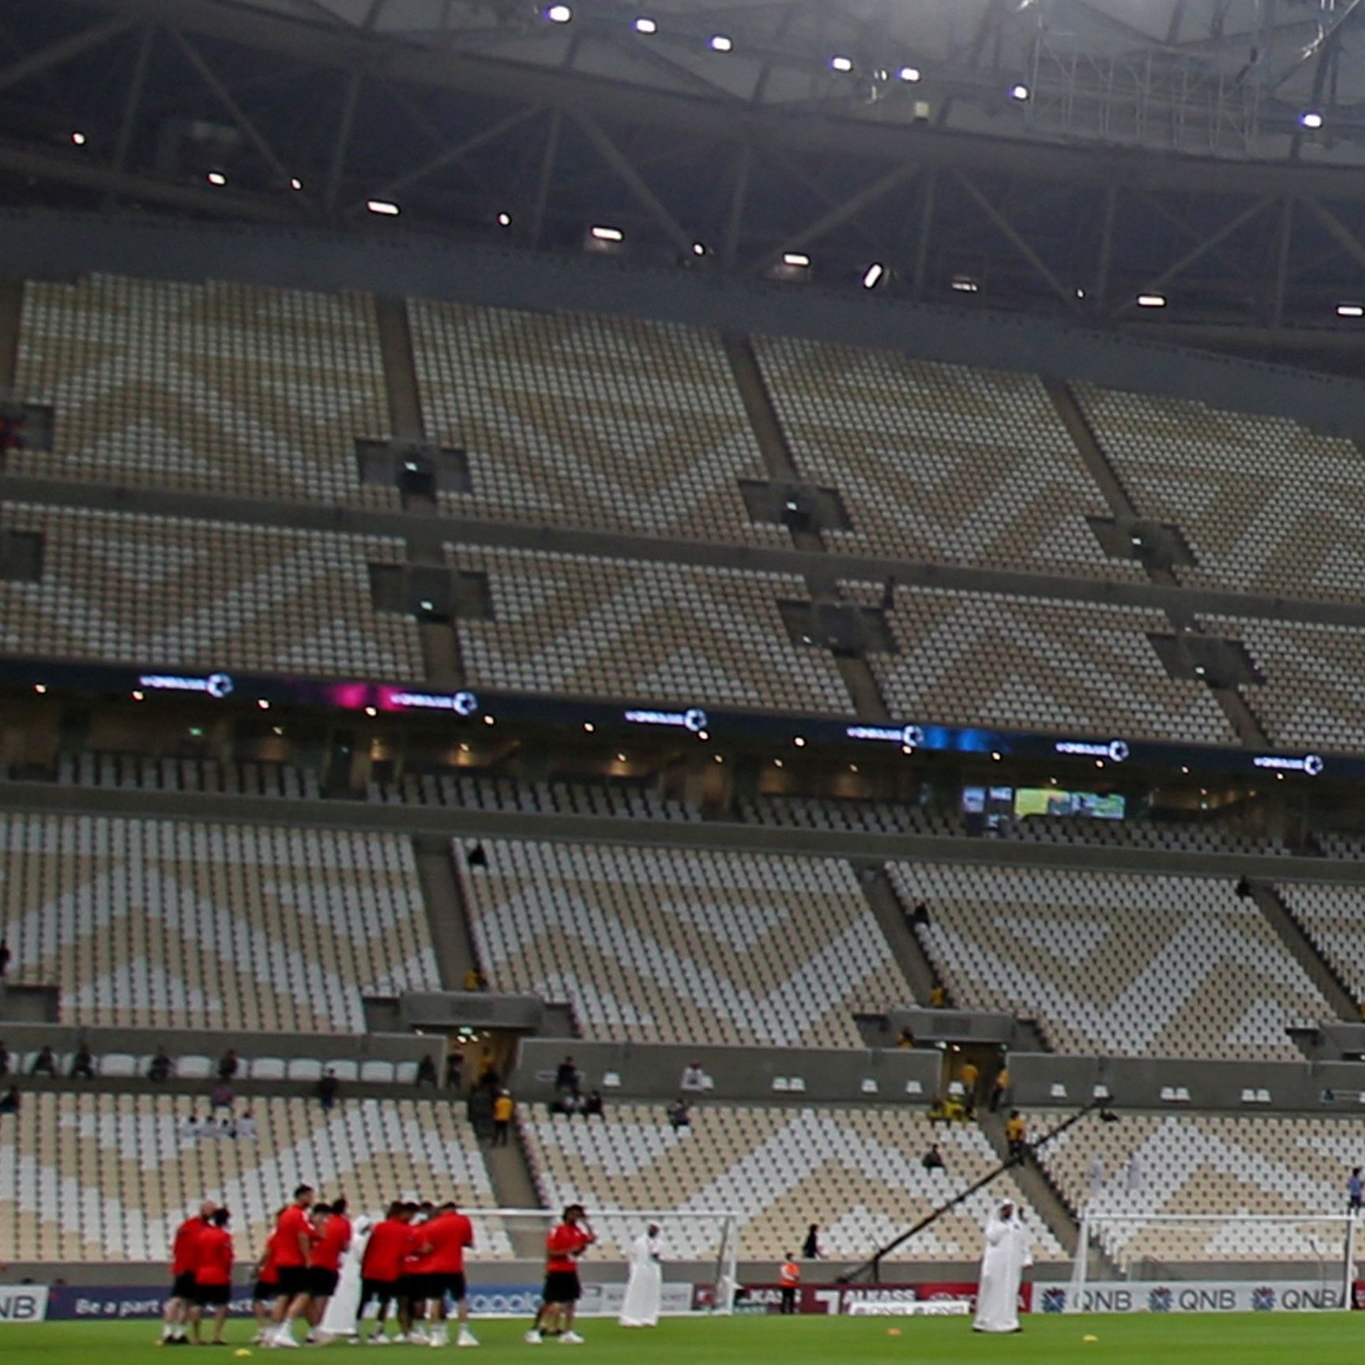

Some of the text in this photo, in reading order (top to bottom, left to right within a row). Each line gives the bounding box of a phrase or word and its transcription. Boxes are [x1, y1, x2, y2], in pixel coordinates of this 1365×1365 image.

[104, 1302, 116, 1314] a
[119, 1300, 159, 1316] part
[1074, 1290, 1132, 1310] QNB
[1179, 1289, 1236, 1310] QNB
[1281, 1289, 1337, 1309] QNB
